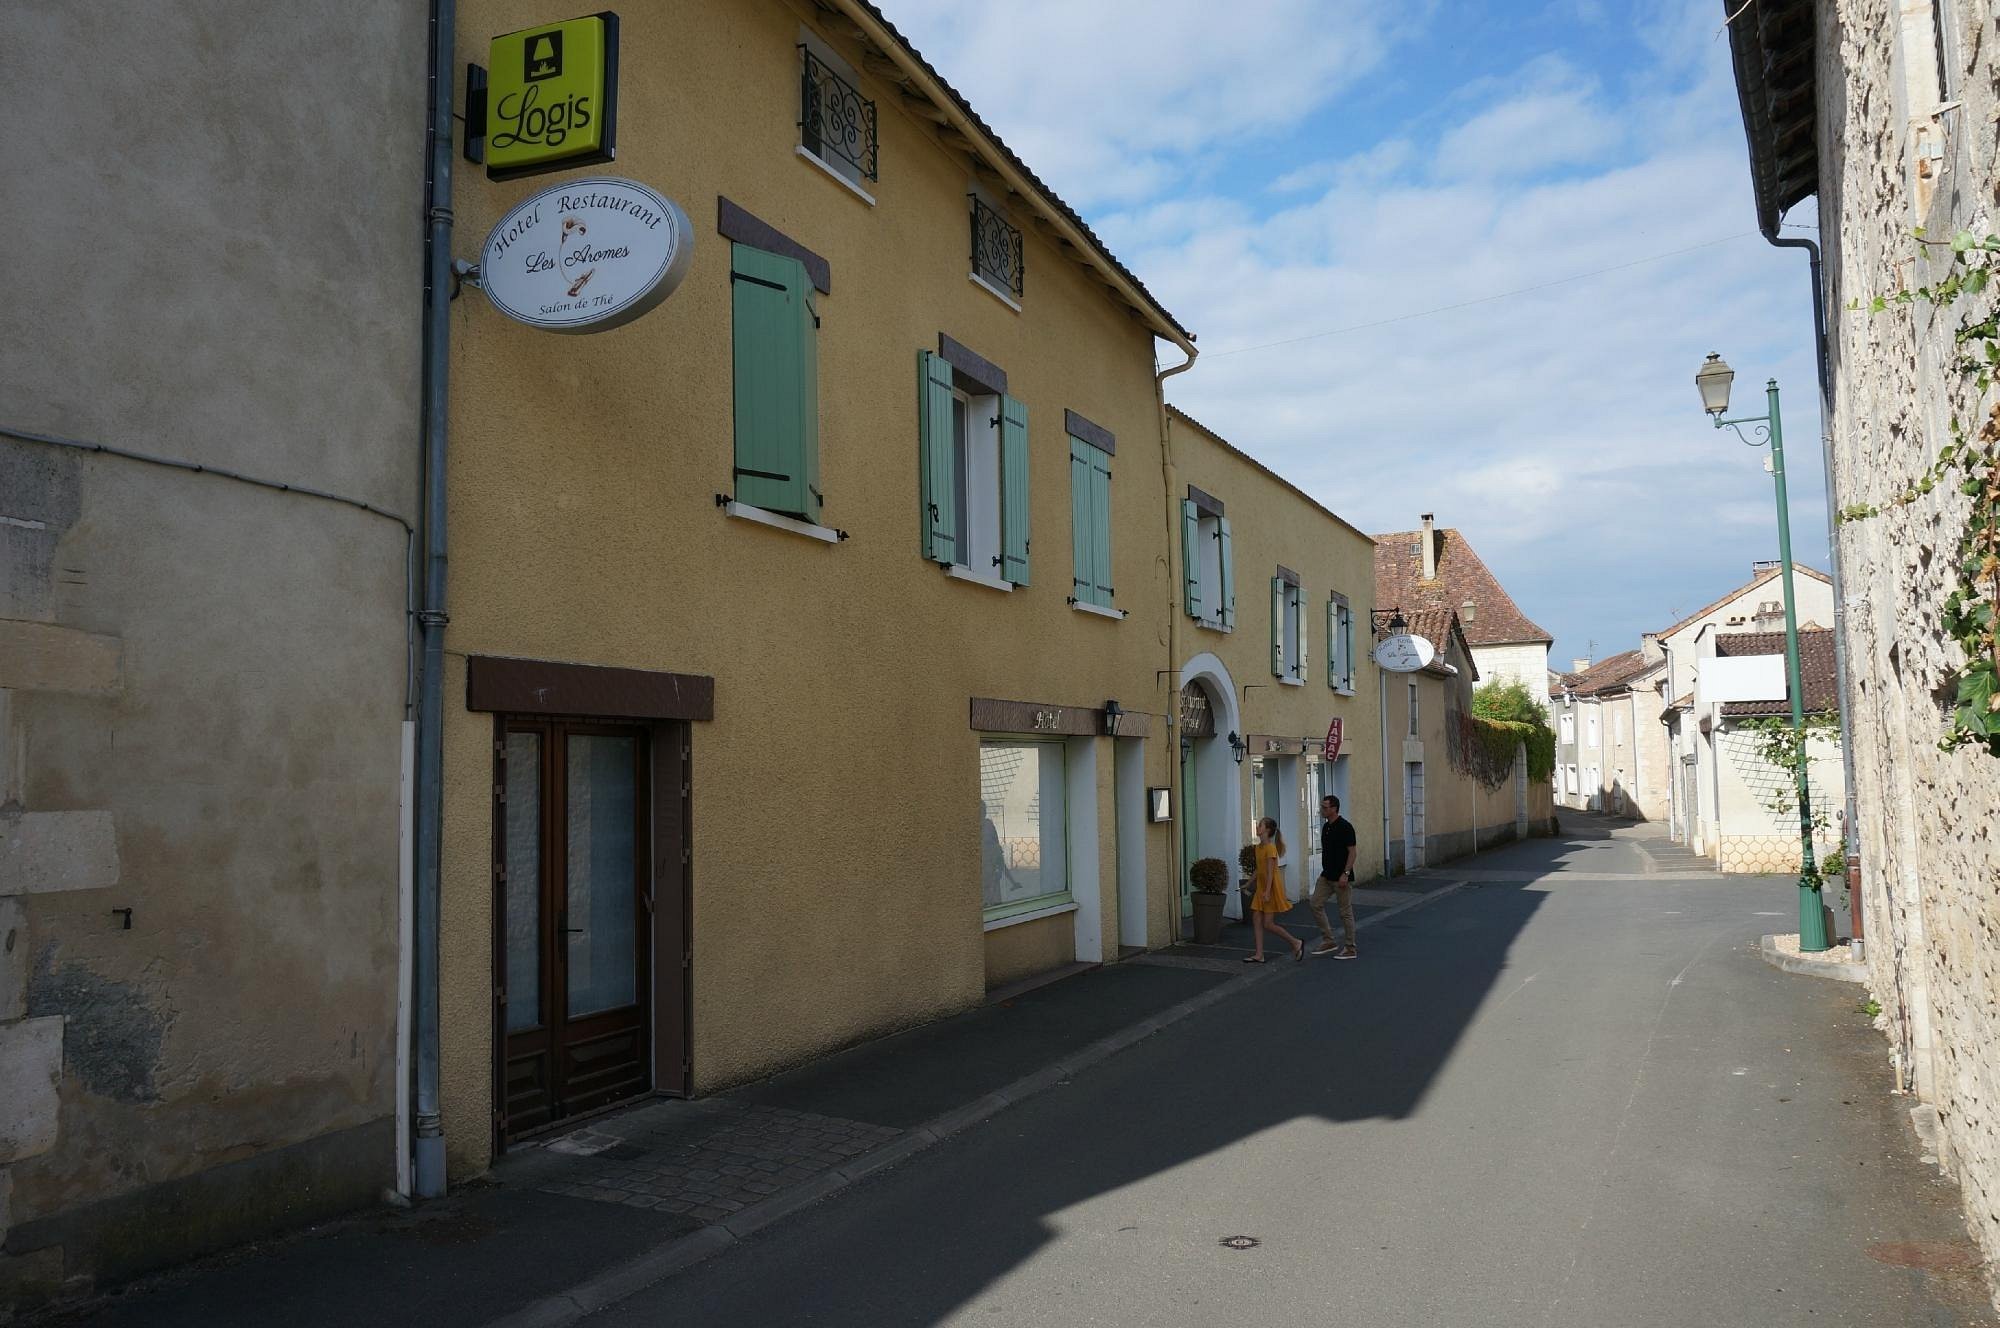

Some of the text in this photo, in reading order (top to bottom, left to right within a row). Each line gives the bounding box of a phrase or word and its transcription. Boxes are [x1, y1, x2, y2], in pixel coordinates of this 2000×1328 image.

[492, 85, 591, 147] Logis
[494, 193, 661, 259] Hotel Restaurant
[525, 244, 630, 274] Les Aromes
[539, 301, 571, 315] Salon
[574, 300, 588, 309] de
[1327, 719, 1339, 760] TABAC
